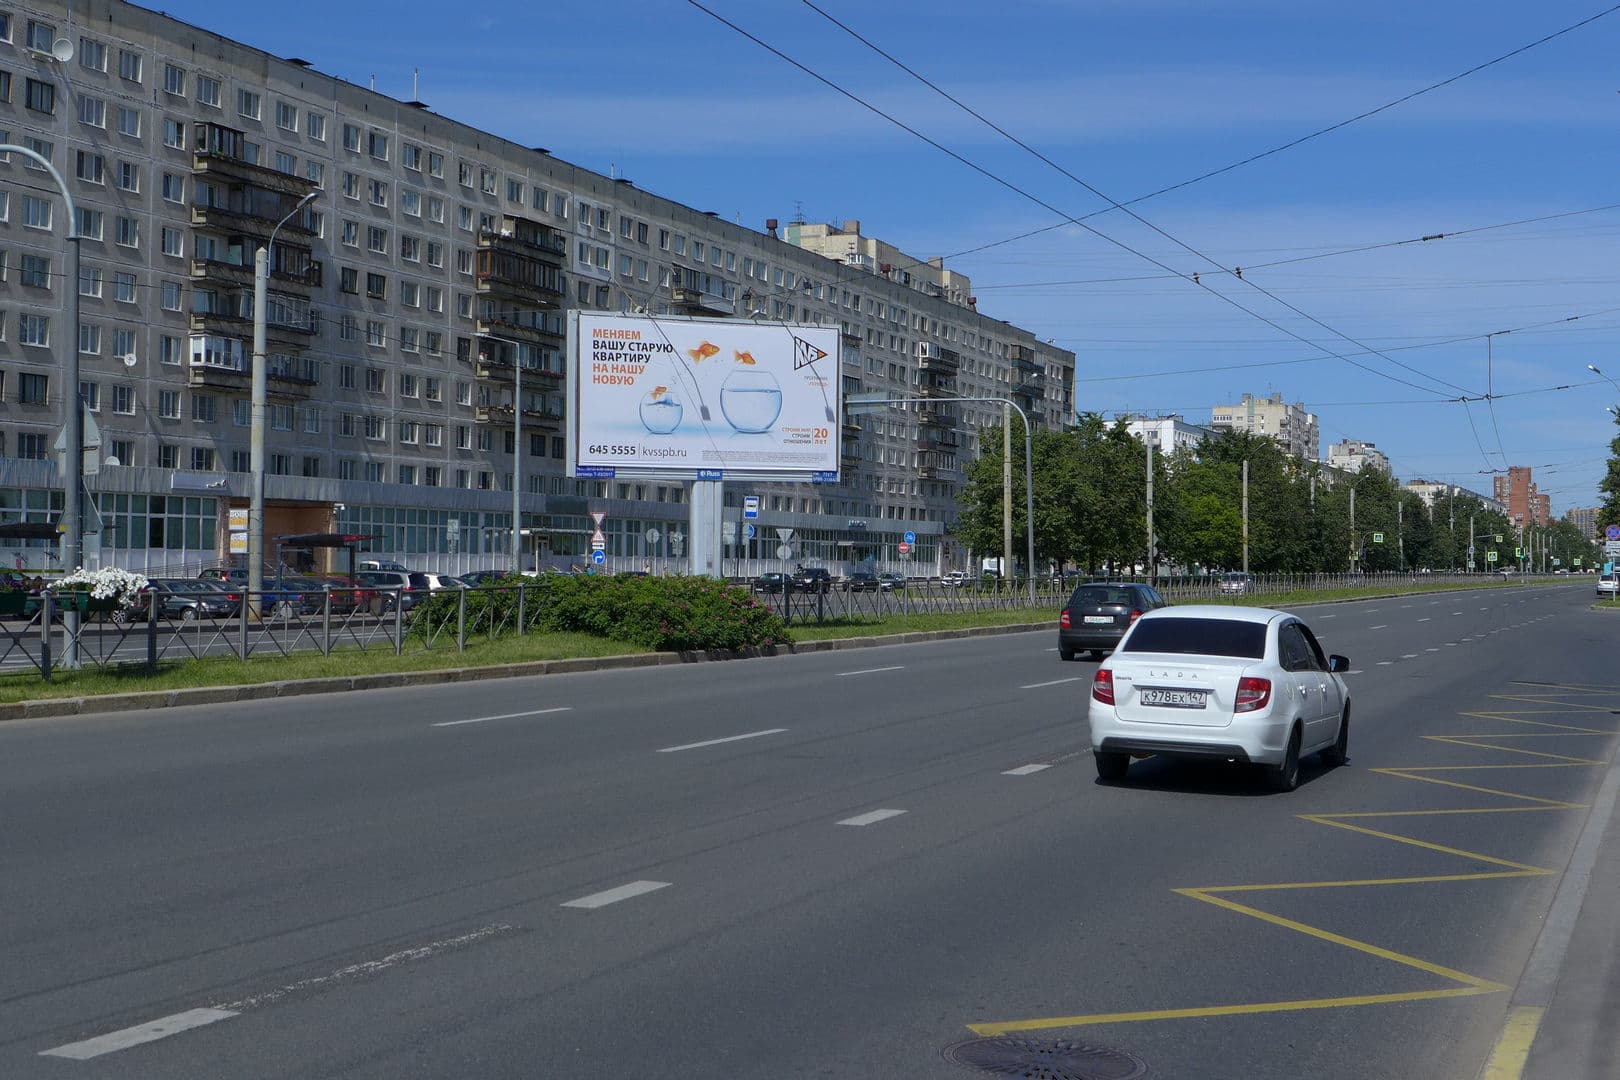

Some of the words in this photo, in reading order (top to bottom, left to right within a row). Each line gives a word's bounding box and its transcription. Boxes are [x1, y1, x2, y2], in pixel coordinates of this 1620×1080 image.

[592, 328, 641, 340] МЕНЯЕМ
[592, 340, 626, 351] ВАШУ
[628, 341, 674, 353] СТАРУЮ
[592, 351, 651, 363] КВАРТИРУ
[592, 363, 609, 373] НА
[611, 364, 645, 375] НАШУ
[592, 374, 635, 386] НОВУЮ
[814, 427, 828, 439] 20
[589, 445, 608, 455] 645
[611, 446, 636, 456] 5555
[642, 446, 687, 459] kvsspb.ru
[1150, 670, 1198, 679] LADA
[1187, 692, 1204, 702] 147
